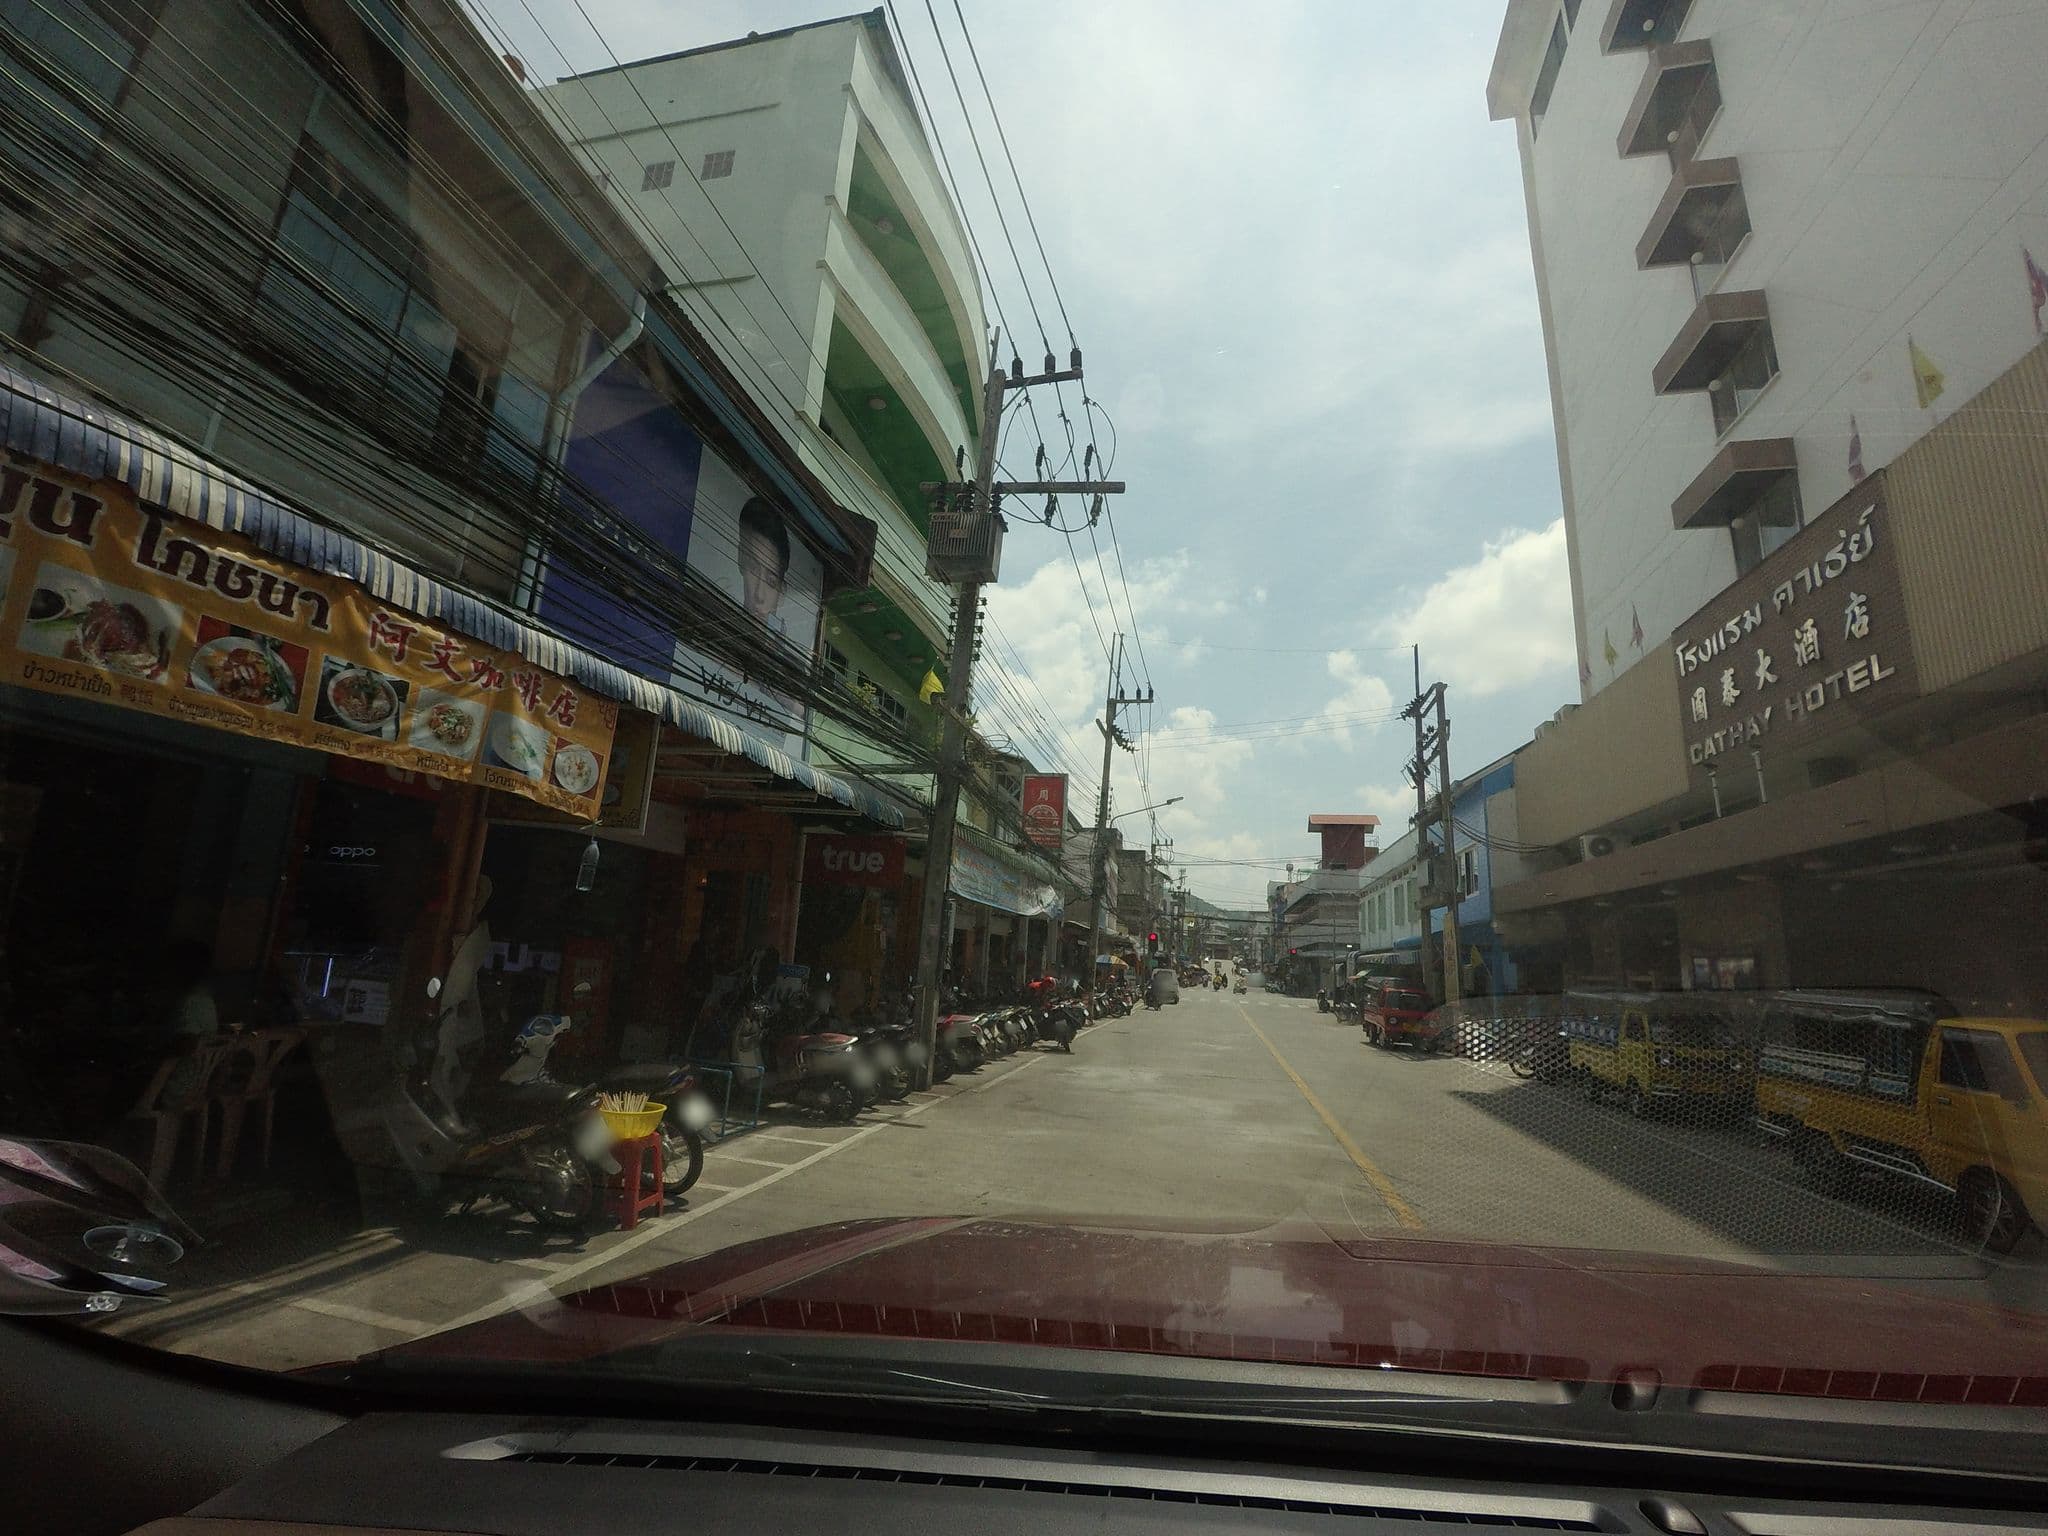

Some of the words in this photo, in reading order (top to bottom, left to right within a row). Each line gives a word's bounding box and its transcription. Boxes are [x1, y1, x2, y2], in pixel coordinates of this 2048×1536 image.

[1676, 602, 1762, 677] โรงแรม
[1690, 706, 1772, 766] CATHAY
[1785, 653, 1896, 721] HOTEL
[822, 844, 886, 873] true
